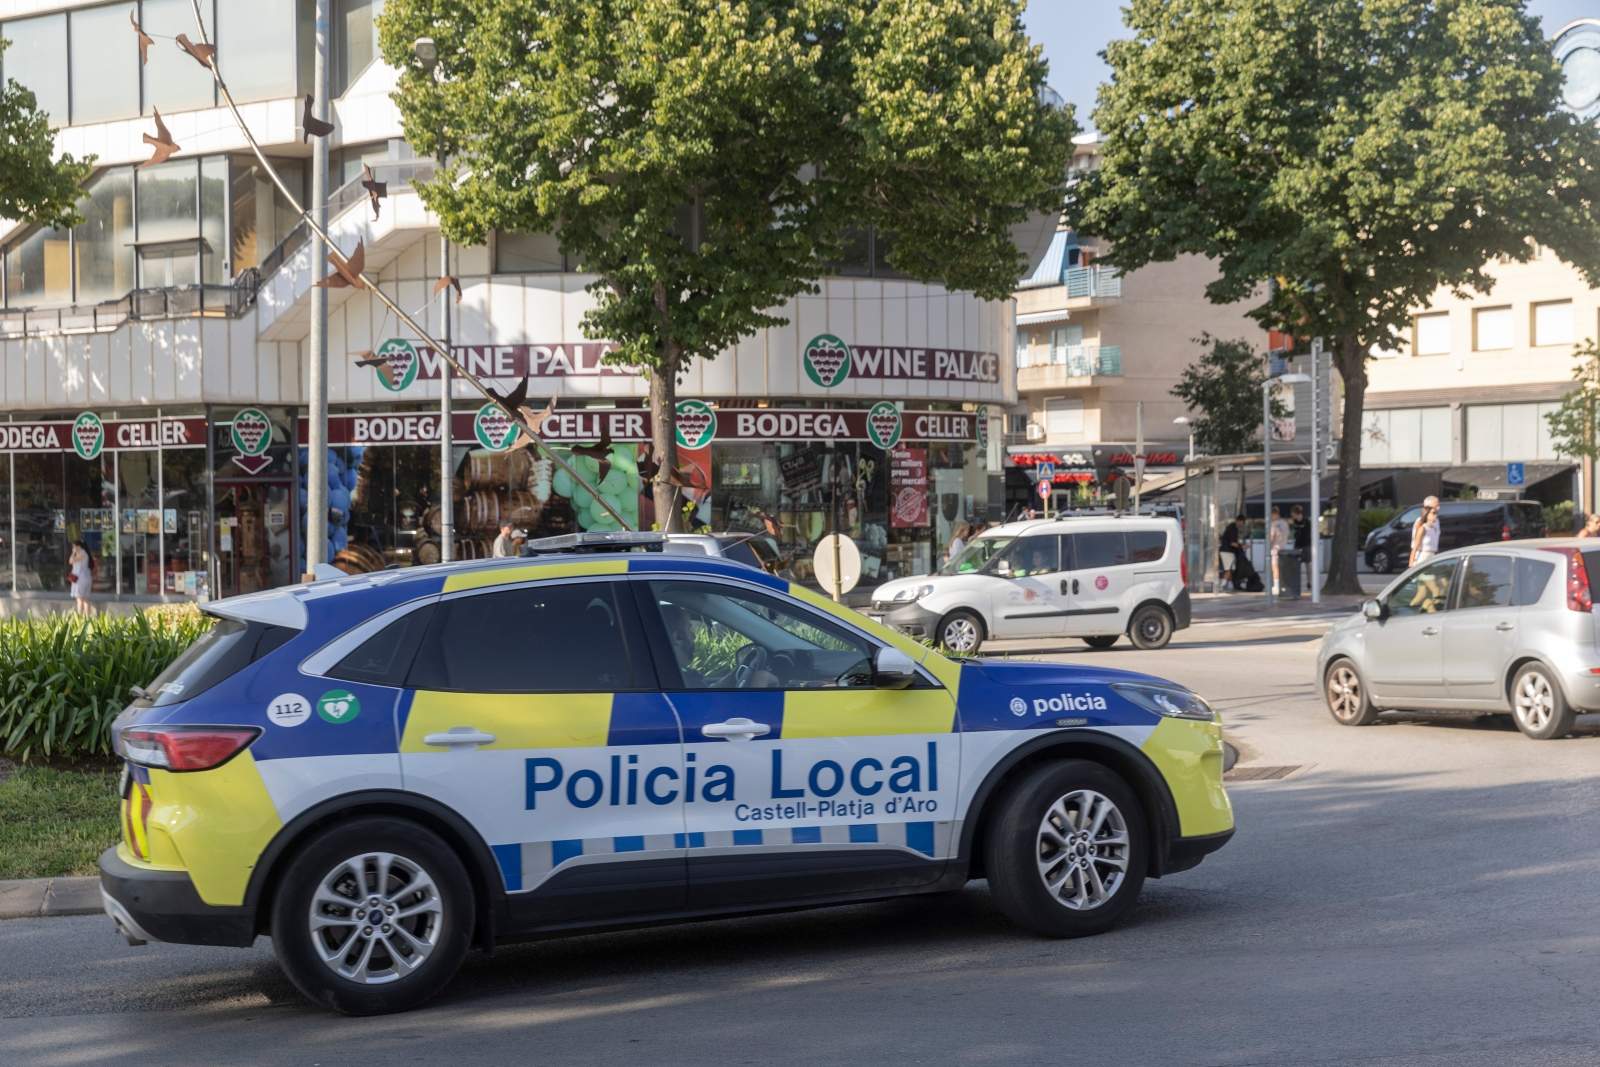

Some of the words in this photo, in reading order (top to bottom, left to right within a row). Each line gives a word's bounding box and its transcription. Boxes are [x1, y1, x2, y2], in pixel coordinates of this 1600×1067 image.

[420, 347, 515, 377] WINE
[529, 346, 645, 375] PALA
[852, 347, 926, 377] WINE
[935, 351, 997, 382] PALACE
[0, 425, 60, 449] ODEGA
[117, 421, 188, 447] CELLER
[541, 414, 646, 438] CELLER
[737, 413, 850, 437] BODEGA
[915, 415, 969, 438] CELLER
[275, 702, 303, 715] 112
[1032, 692, 1108, 717] policia
[525, 753, 735, 811] Policia
[771, 741, 938, 800] Local
[734, 797, 874, 823] Castell-Platja
[884, 796, 938, 814] d'Aro
